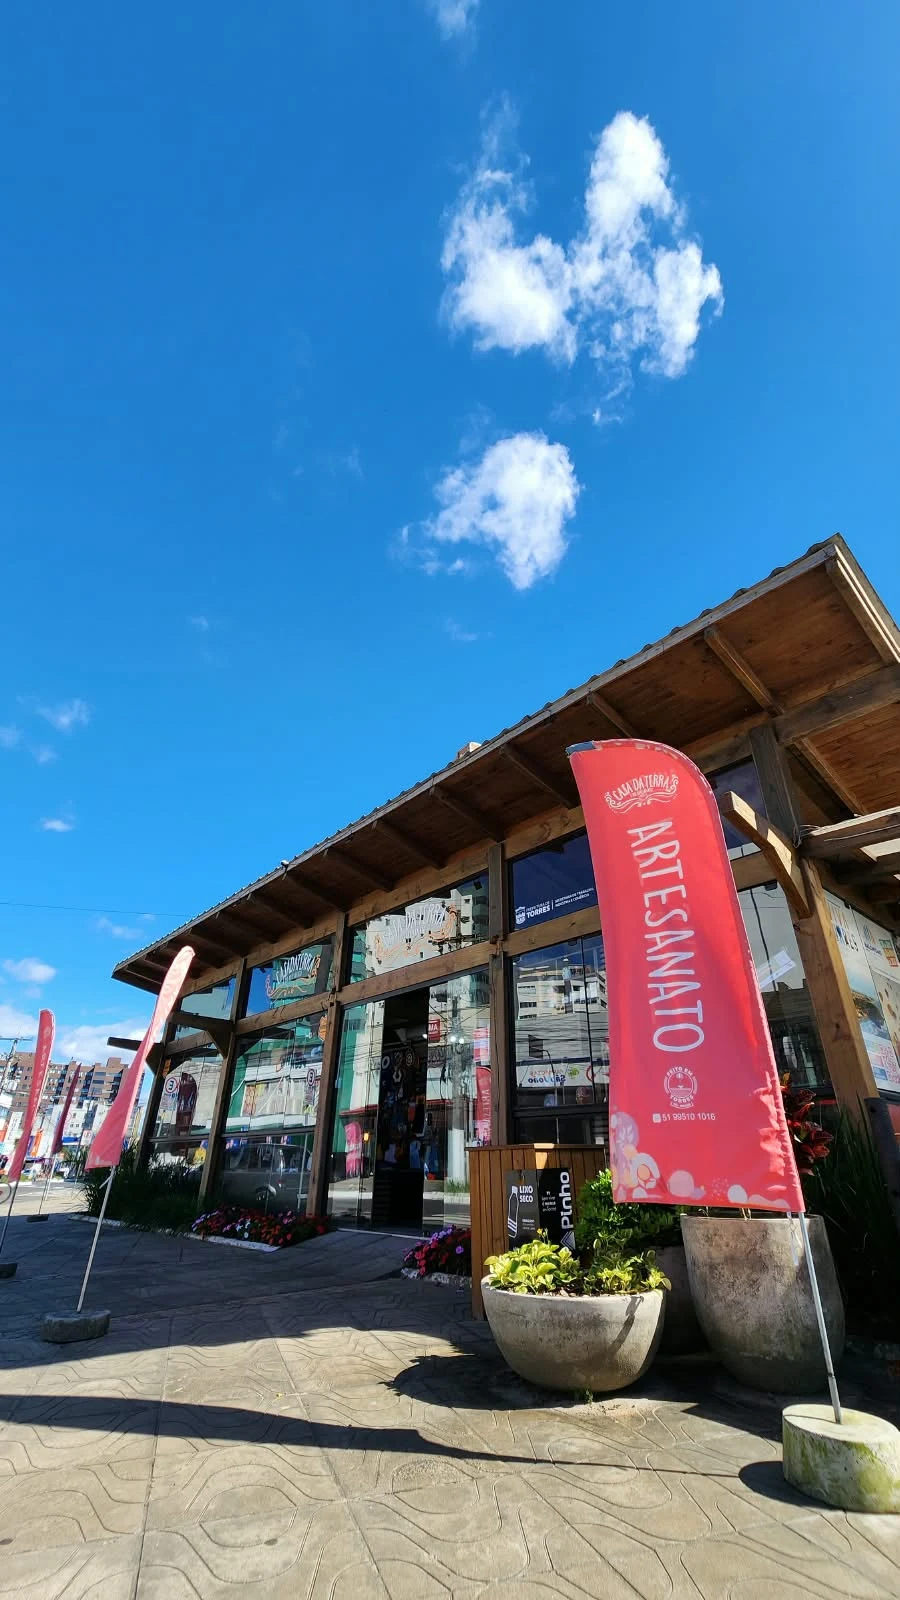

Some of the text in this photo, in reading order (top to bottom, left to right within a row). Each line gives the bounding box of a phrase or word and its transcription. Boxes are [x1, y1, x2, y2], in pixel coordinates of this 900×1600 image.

[612, 782, 633, 801] CASA
[632, 777, 645, 792] DA
[644, 774, 669, 791] TERRA
[526, 904, 551, 919] TORRES
[627, 820, 705, 1052] ARTESANATO
[666, 1066, 683, 1077] FEITO
[662, 1112, 716, 1121] 51 99510 1016
[519, 1185, 534, 1194] LIXO
[519, 1195, 534, 1203] SECO
